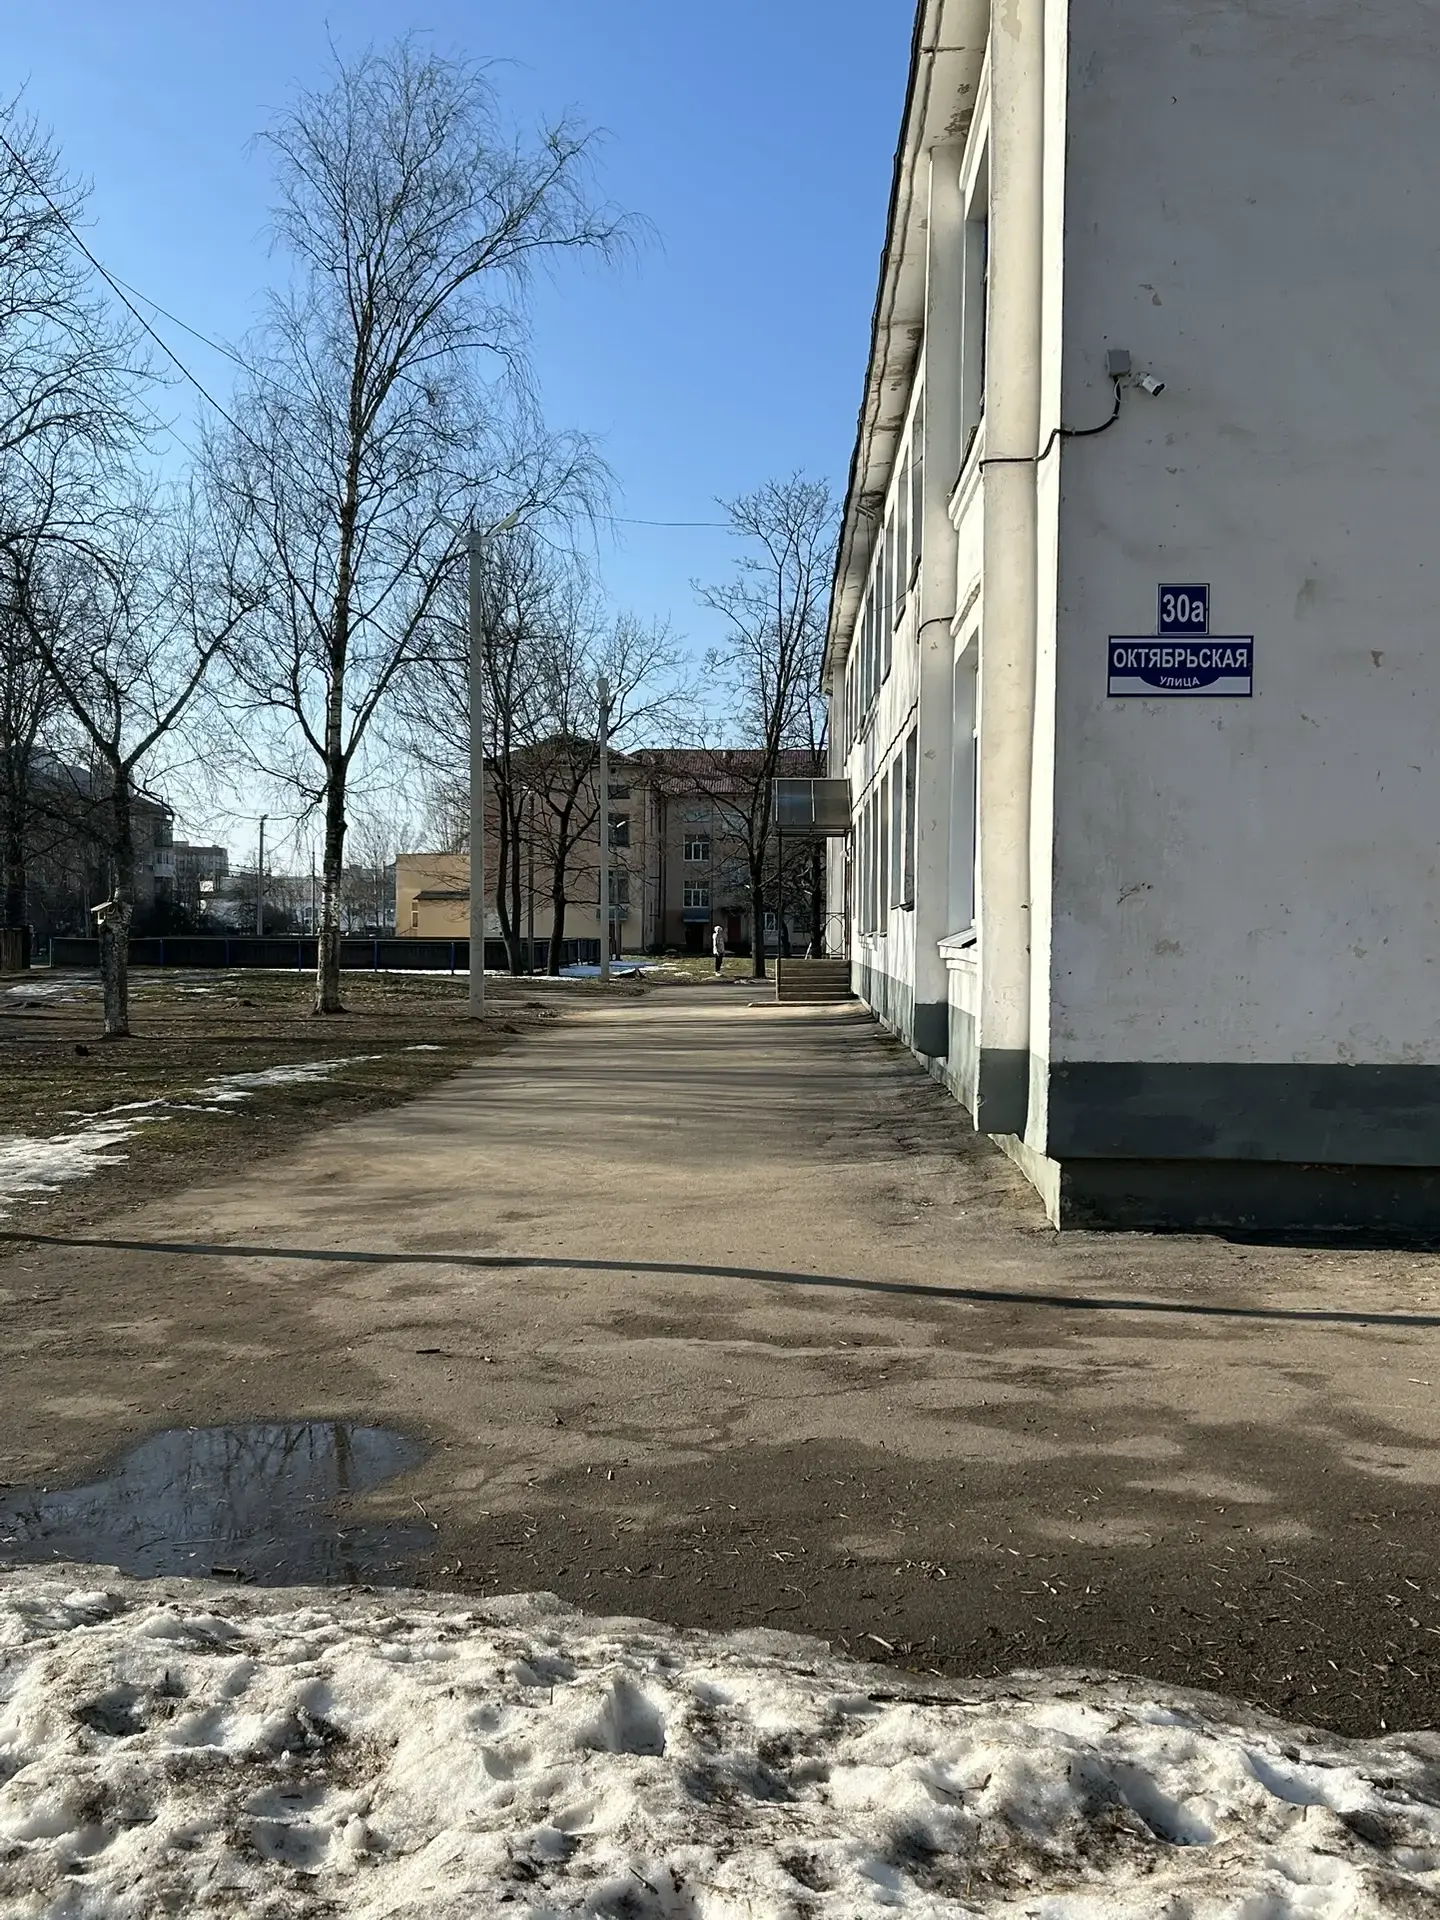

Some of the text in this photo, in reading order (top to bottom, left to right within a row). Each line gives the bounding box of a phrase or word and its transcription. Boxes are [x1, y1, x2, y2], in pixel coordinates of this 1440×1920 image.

[1162, 594, 1204, 623] 30а
[1113, 648, 1248, 668] ОКТЯБРЬСКАЯ
[1159, 676, 1200, 687] УЛИЦА
